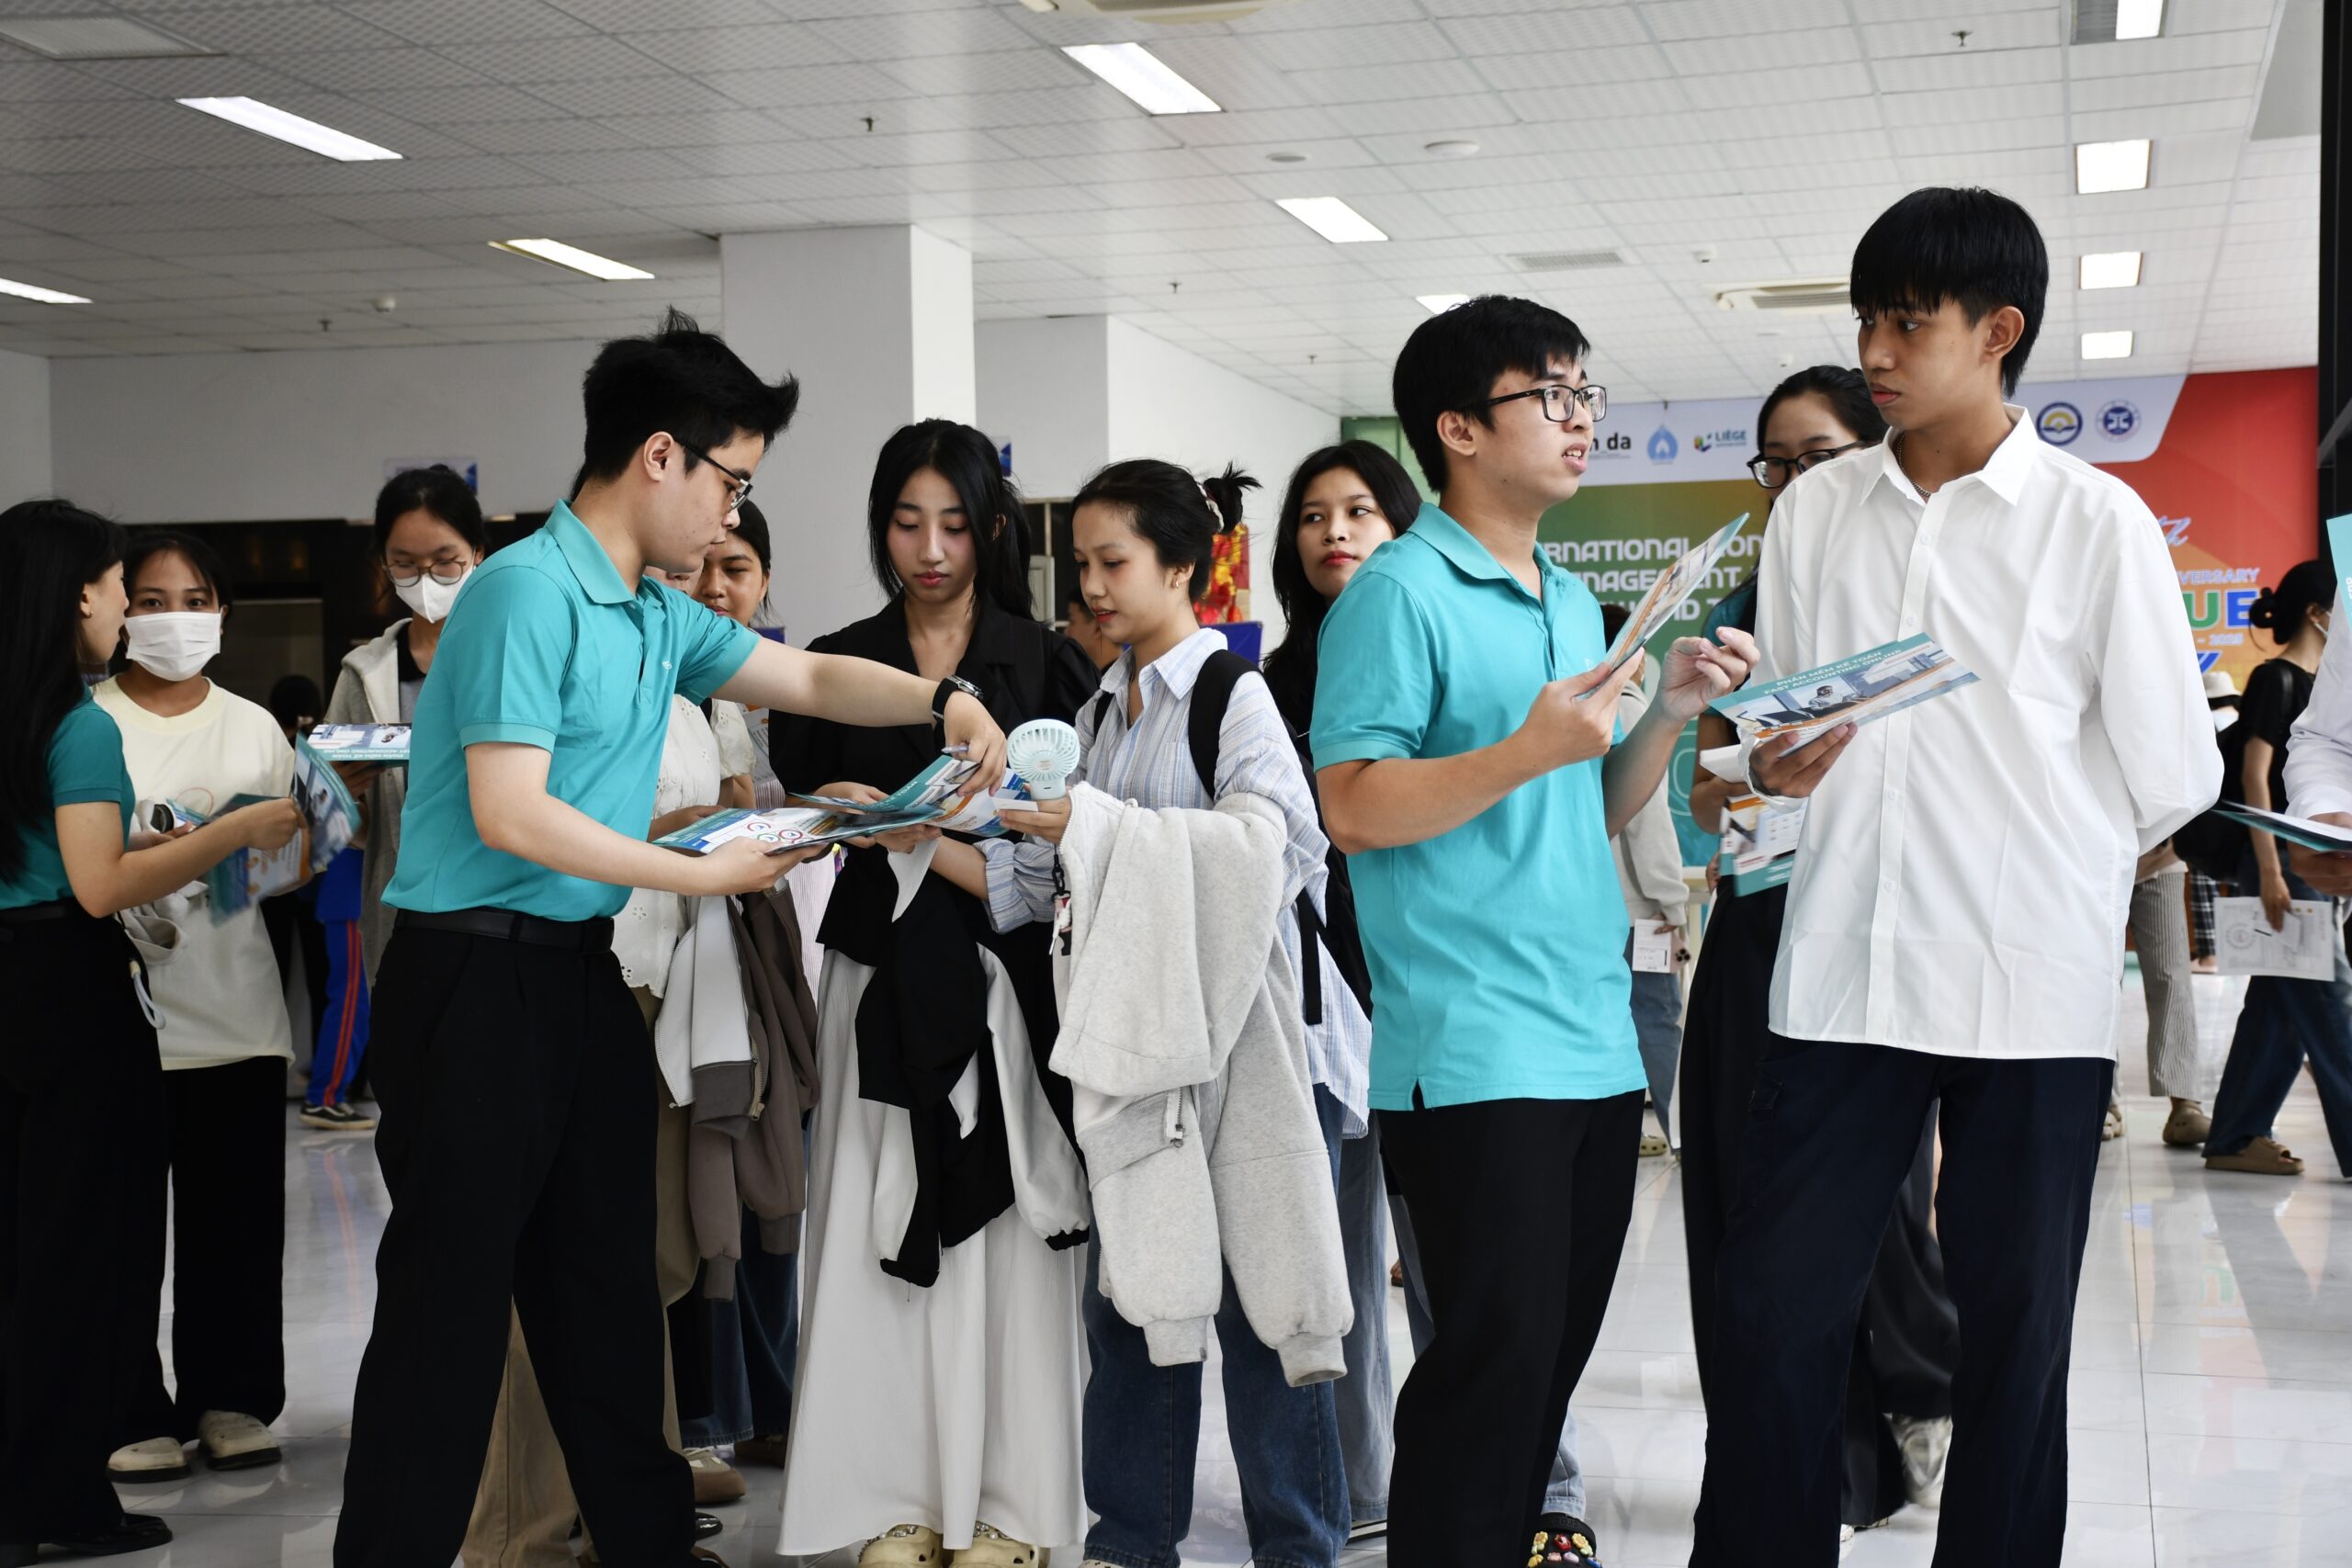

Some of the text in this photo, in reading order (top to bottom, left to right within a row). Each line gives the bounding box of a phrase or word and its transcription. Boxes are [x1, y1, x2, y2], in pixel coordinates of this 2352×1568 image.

[1607, 433, 1631, 450] da
[1541, 535, 1763, 563] RNATIONAL ON
[2177, 567, 2260, 585] VERSARY
